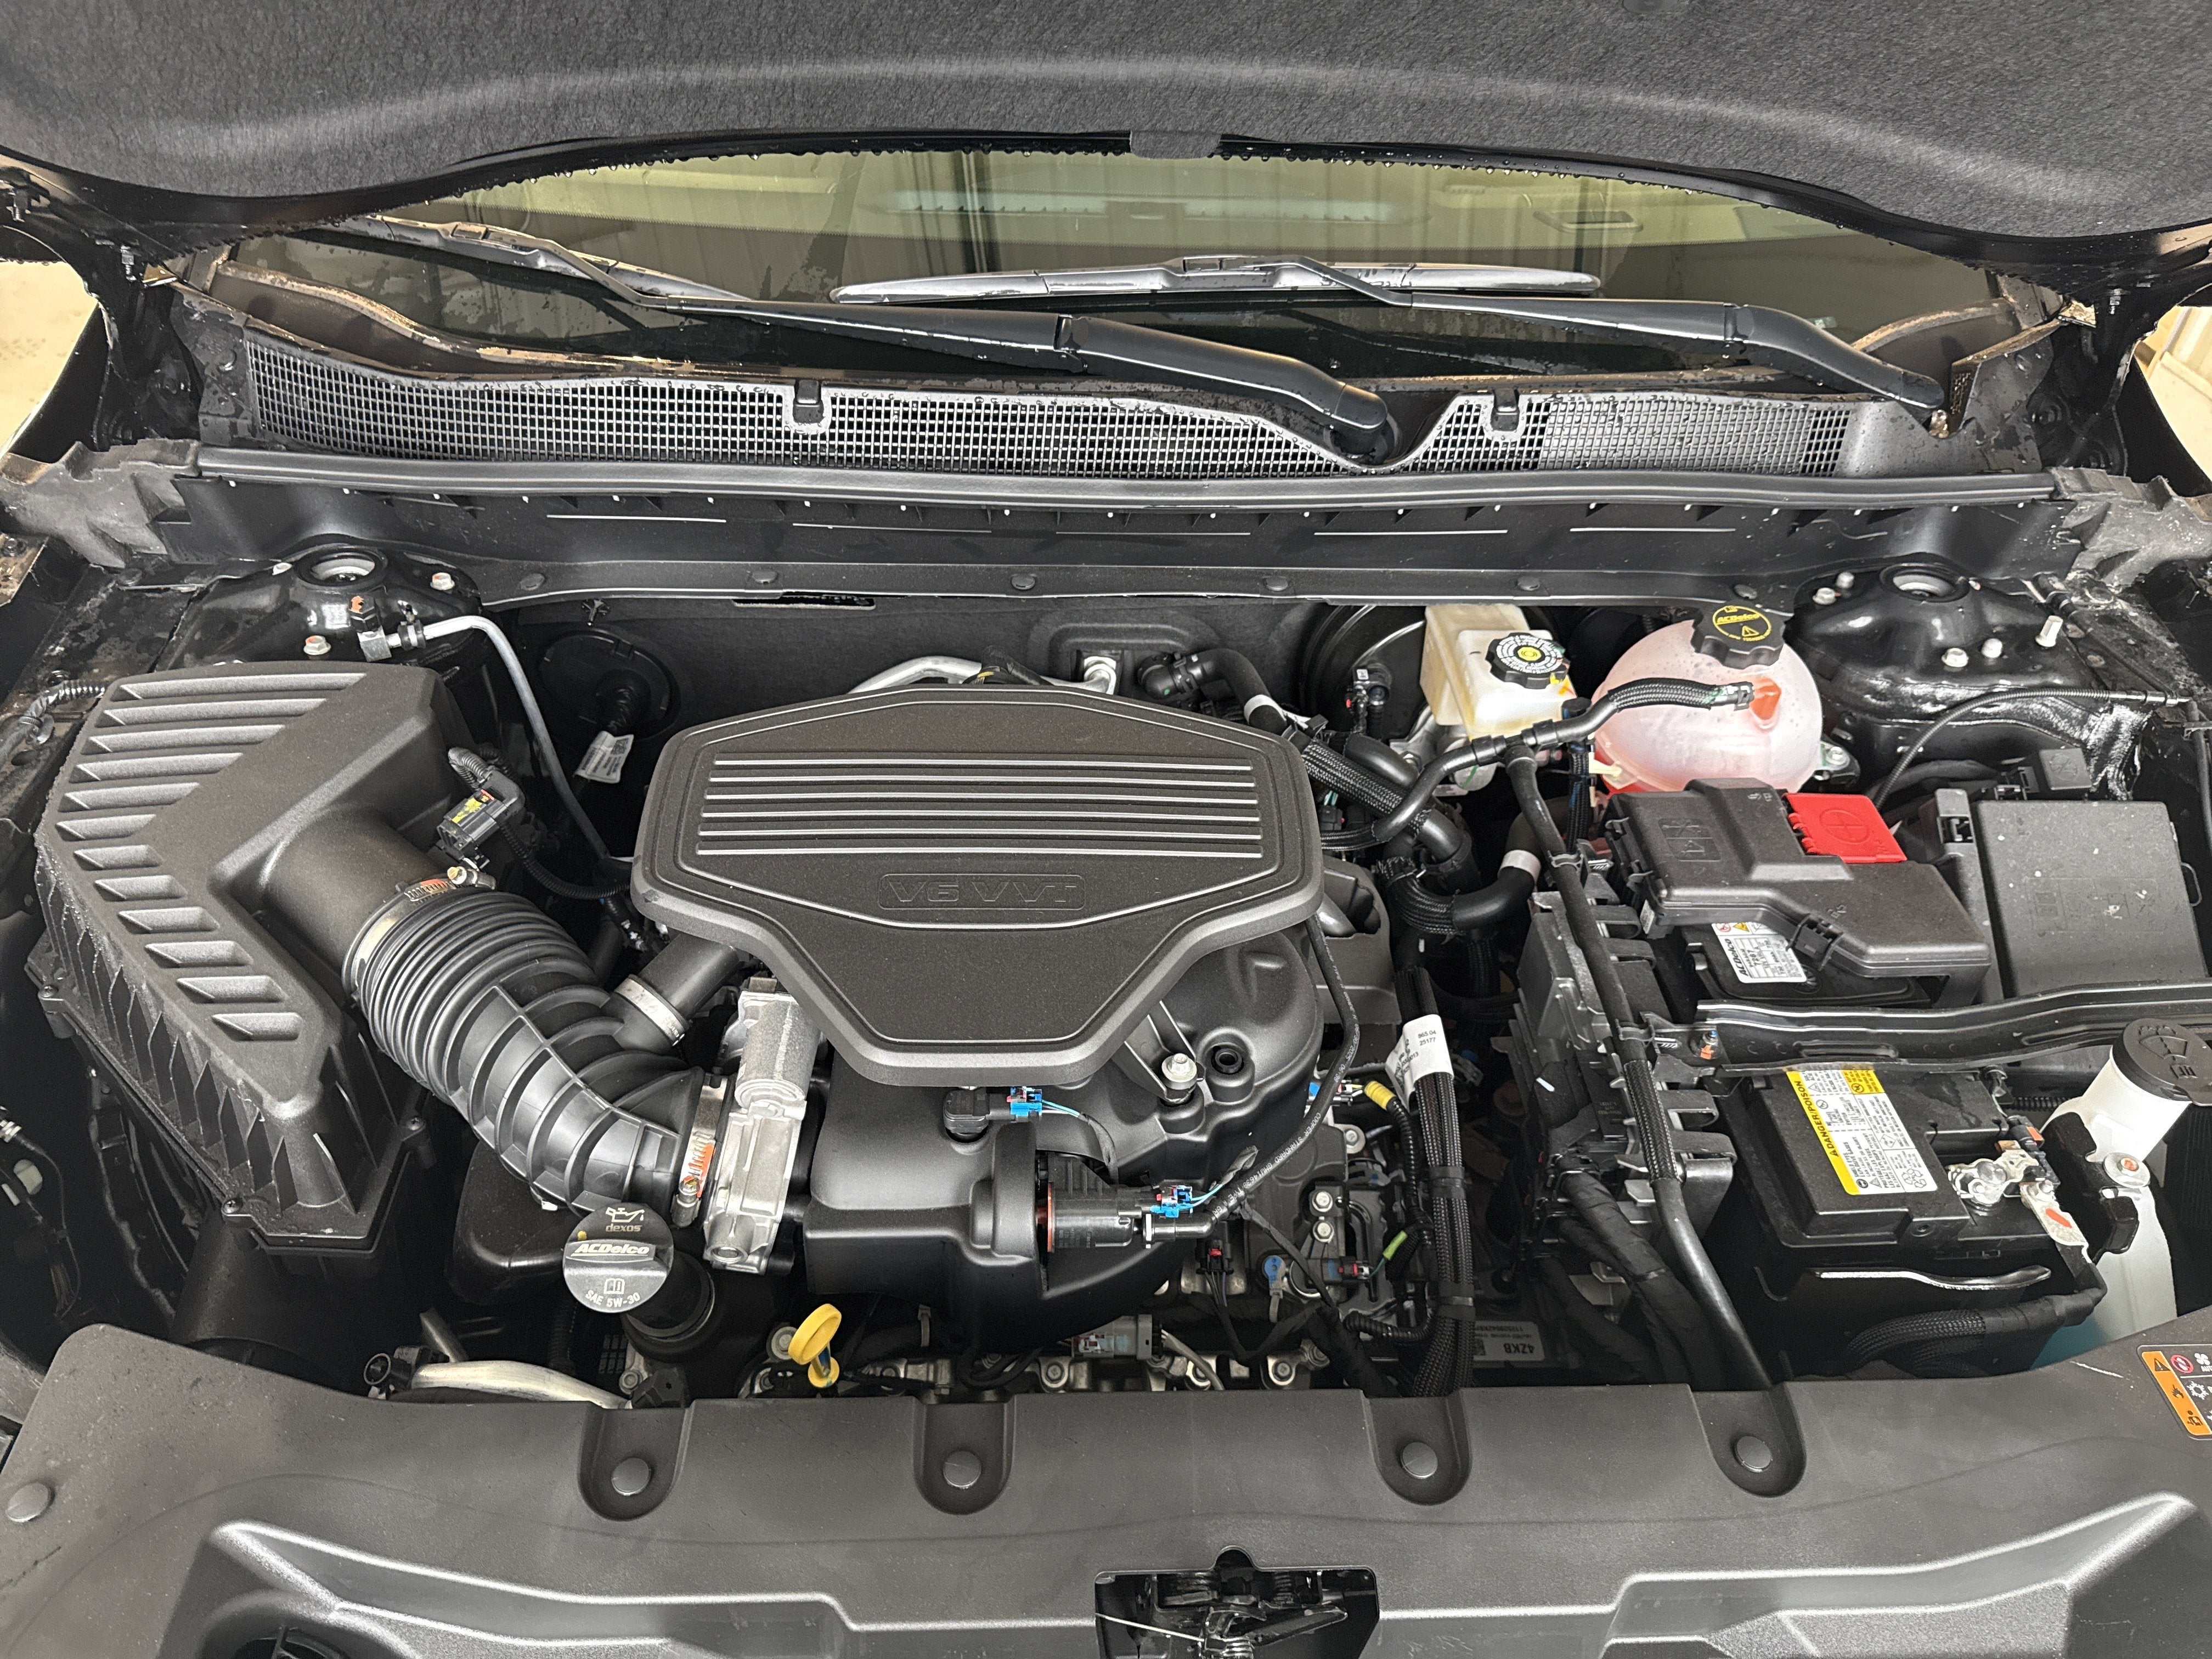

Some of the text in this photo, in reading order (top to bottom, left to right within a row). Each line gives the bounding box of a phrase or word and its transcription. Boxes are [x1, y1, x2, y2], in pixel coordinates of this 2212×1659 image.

[888, 881, 959, 902] V6
[1724, 938, 1749, 976] ACDelco
[1304, 1112, 1321, 1137] COOPER
[1794, 1080, 1835, 1149] DANGER/POISON
[1274, 1136, 1303, 1163] STANDARD
[605, 1223, 642, 1233] dexos
[574, 1243, 650, 1254] ACDelco
[585, 1290, 641, 1308] SAE 5W-30
